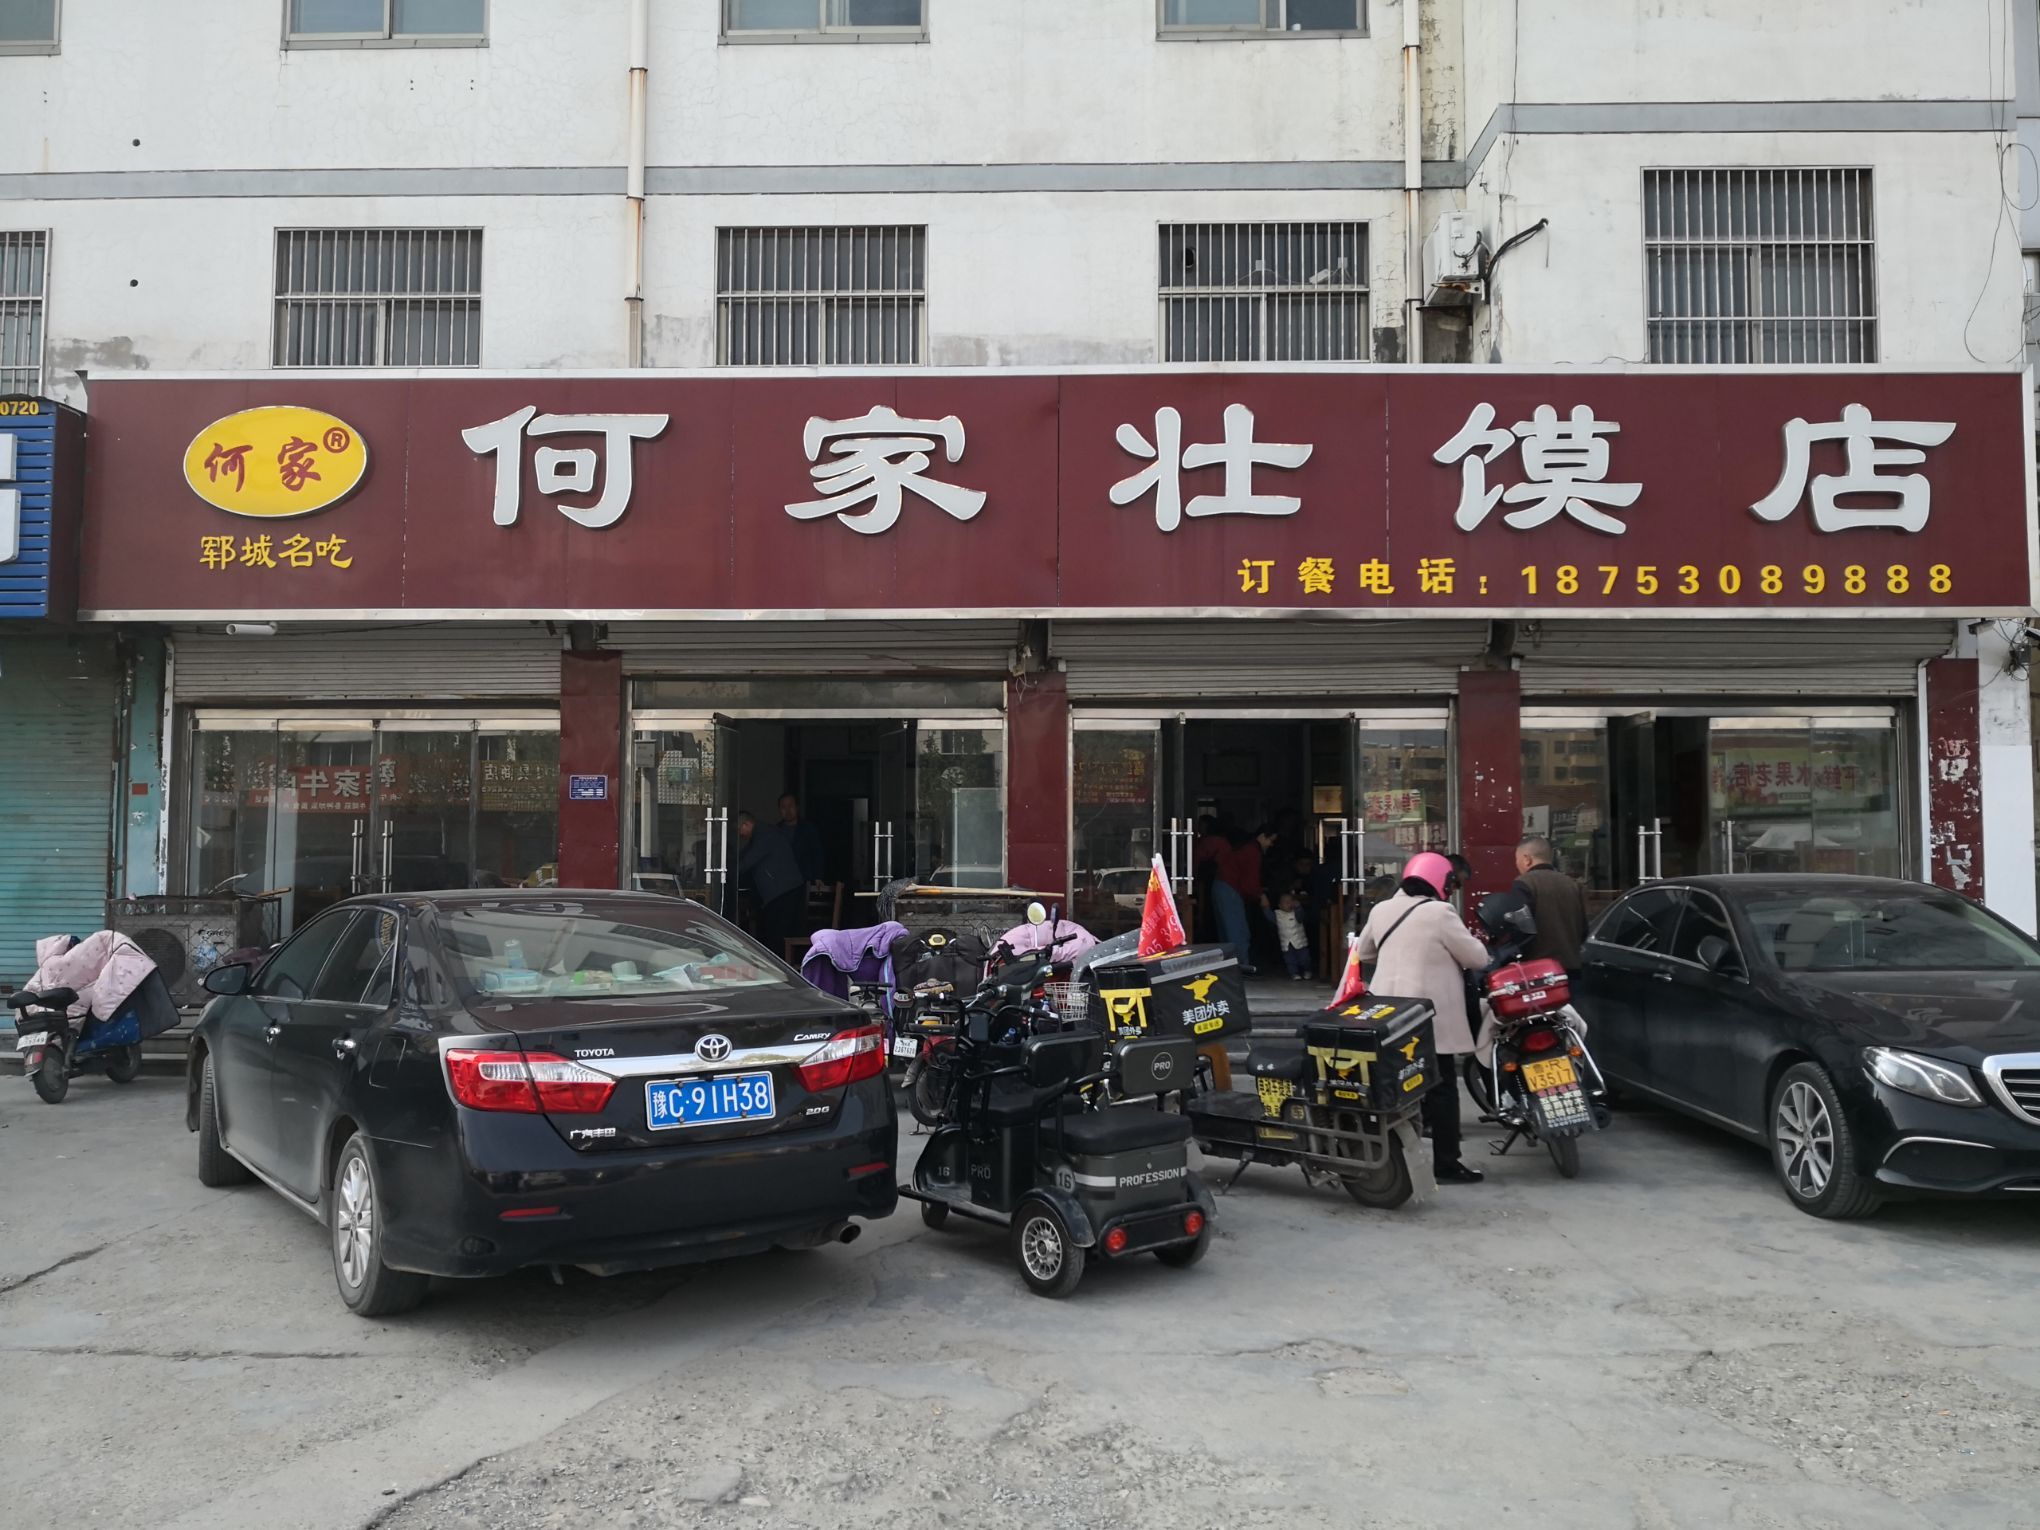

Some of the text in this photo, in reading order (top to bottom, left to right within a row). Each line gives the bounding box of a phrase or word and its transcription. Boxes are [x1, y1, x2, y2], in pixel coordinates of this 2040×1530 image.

[204, 436, 321, 493] 何家
[462, 400, 1957, 536] 何家壮馍店
[200, 533, 353, 570] 郓城名吃
[1182, 1000, 1230, 1026] 美团外卖
[793, 1032, 831, 1042] CAMRY
[574, 1048, 615, 1058] TOYOTA
[1153, 1061, 1171, 1071] PRO
[570, 1127, 616, 1139] 广汽丰田
[938, 1166, 950, 1177] 16
[970, 1164, 991, 1180] PRO
[1119, 1168, 1180, 1188] PROFESSION
[1058, 1172, 1072, 1190] 16
